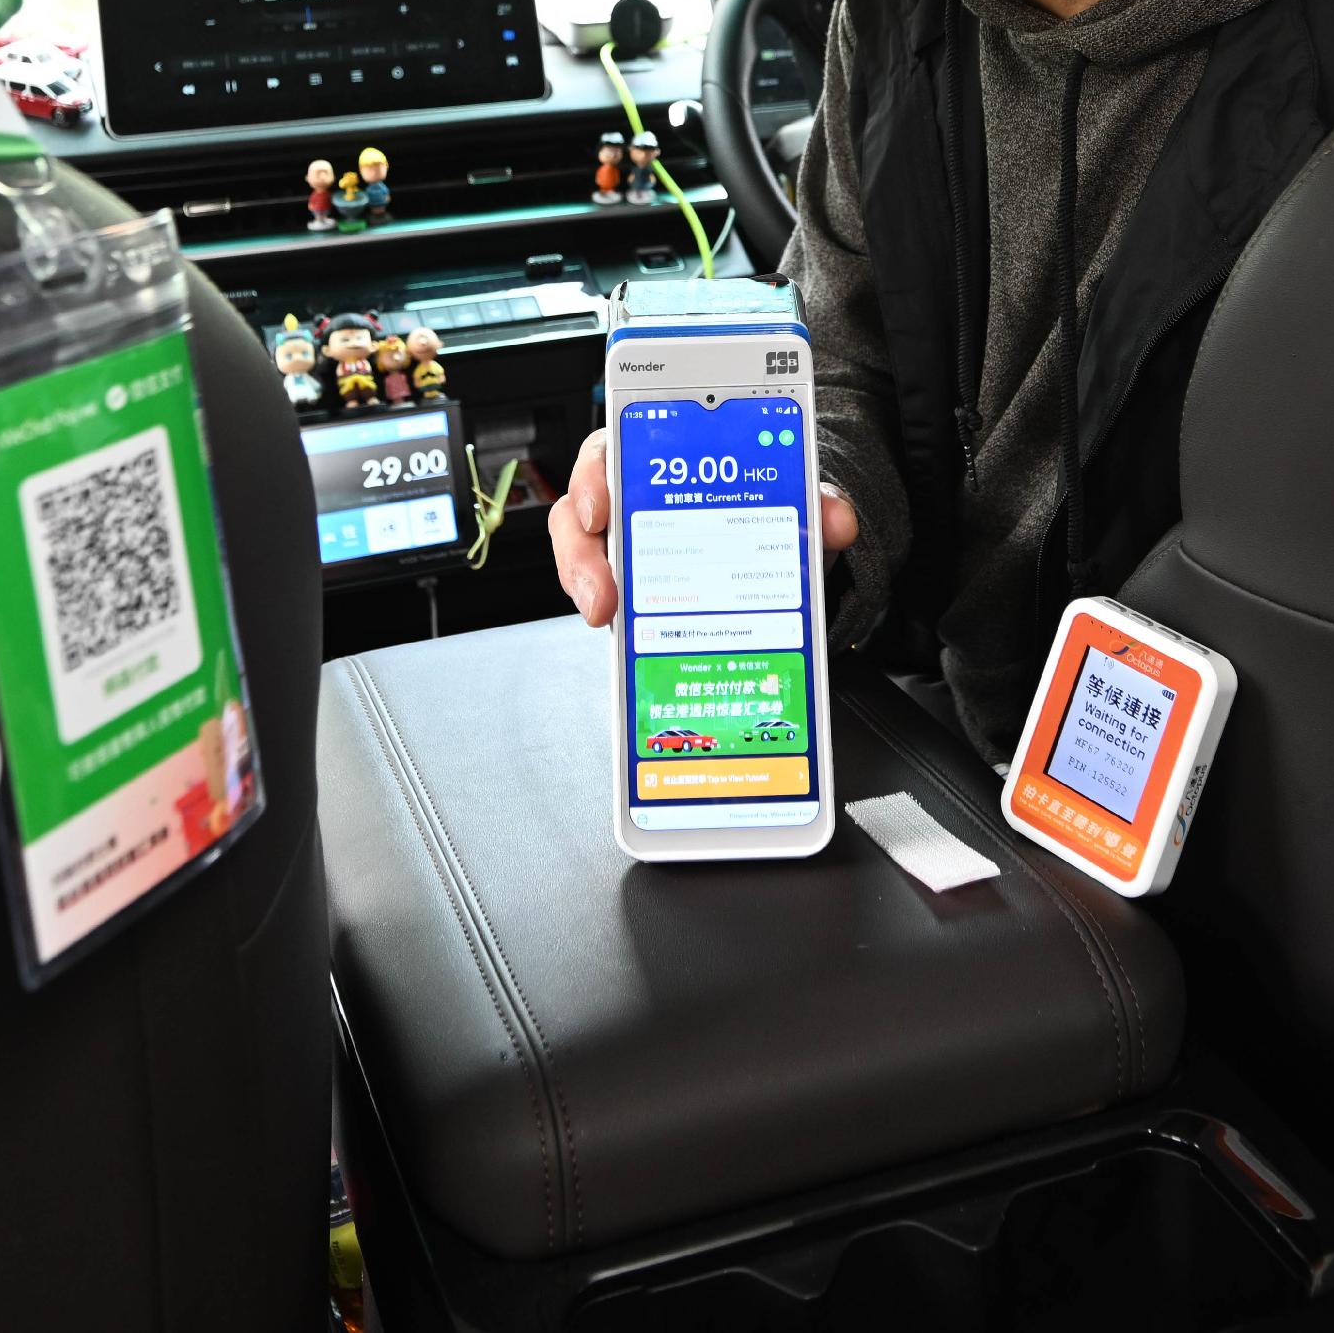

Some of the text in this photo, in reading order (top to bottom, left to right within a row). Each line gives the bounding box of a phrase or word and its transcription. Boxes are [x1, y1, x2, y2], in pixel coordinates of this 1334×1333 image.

[619, 361, 666, 373] Wonder
[766, 351, 799, 375] JCB
[362, 449, 447, 489] 29.00
[649, 456, 778, 485] 29.00 HKD
[664, 491, 764, 505] 當前車資 Current Fare
[727, 517, 750, 525] WONG
[731, 572, 773, 580] 01/03/2026
[725, 629, 753, 637] Payment
[680, 663, 712, 673] Wonder
[1126, 654, 1161, 677] Octopus
[675, 680, 756, 697] 微信支付付款
[1086, 674, 1162, 730] 等候連接
[1085, 700, 1149, 744] Waiting for
[1078, 716, 1146, 761] connection
[1106, 753, 1135, 776] 76320
[1186, 763, 1208, 816] Octopus
